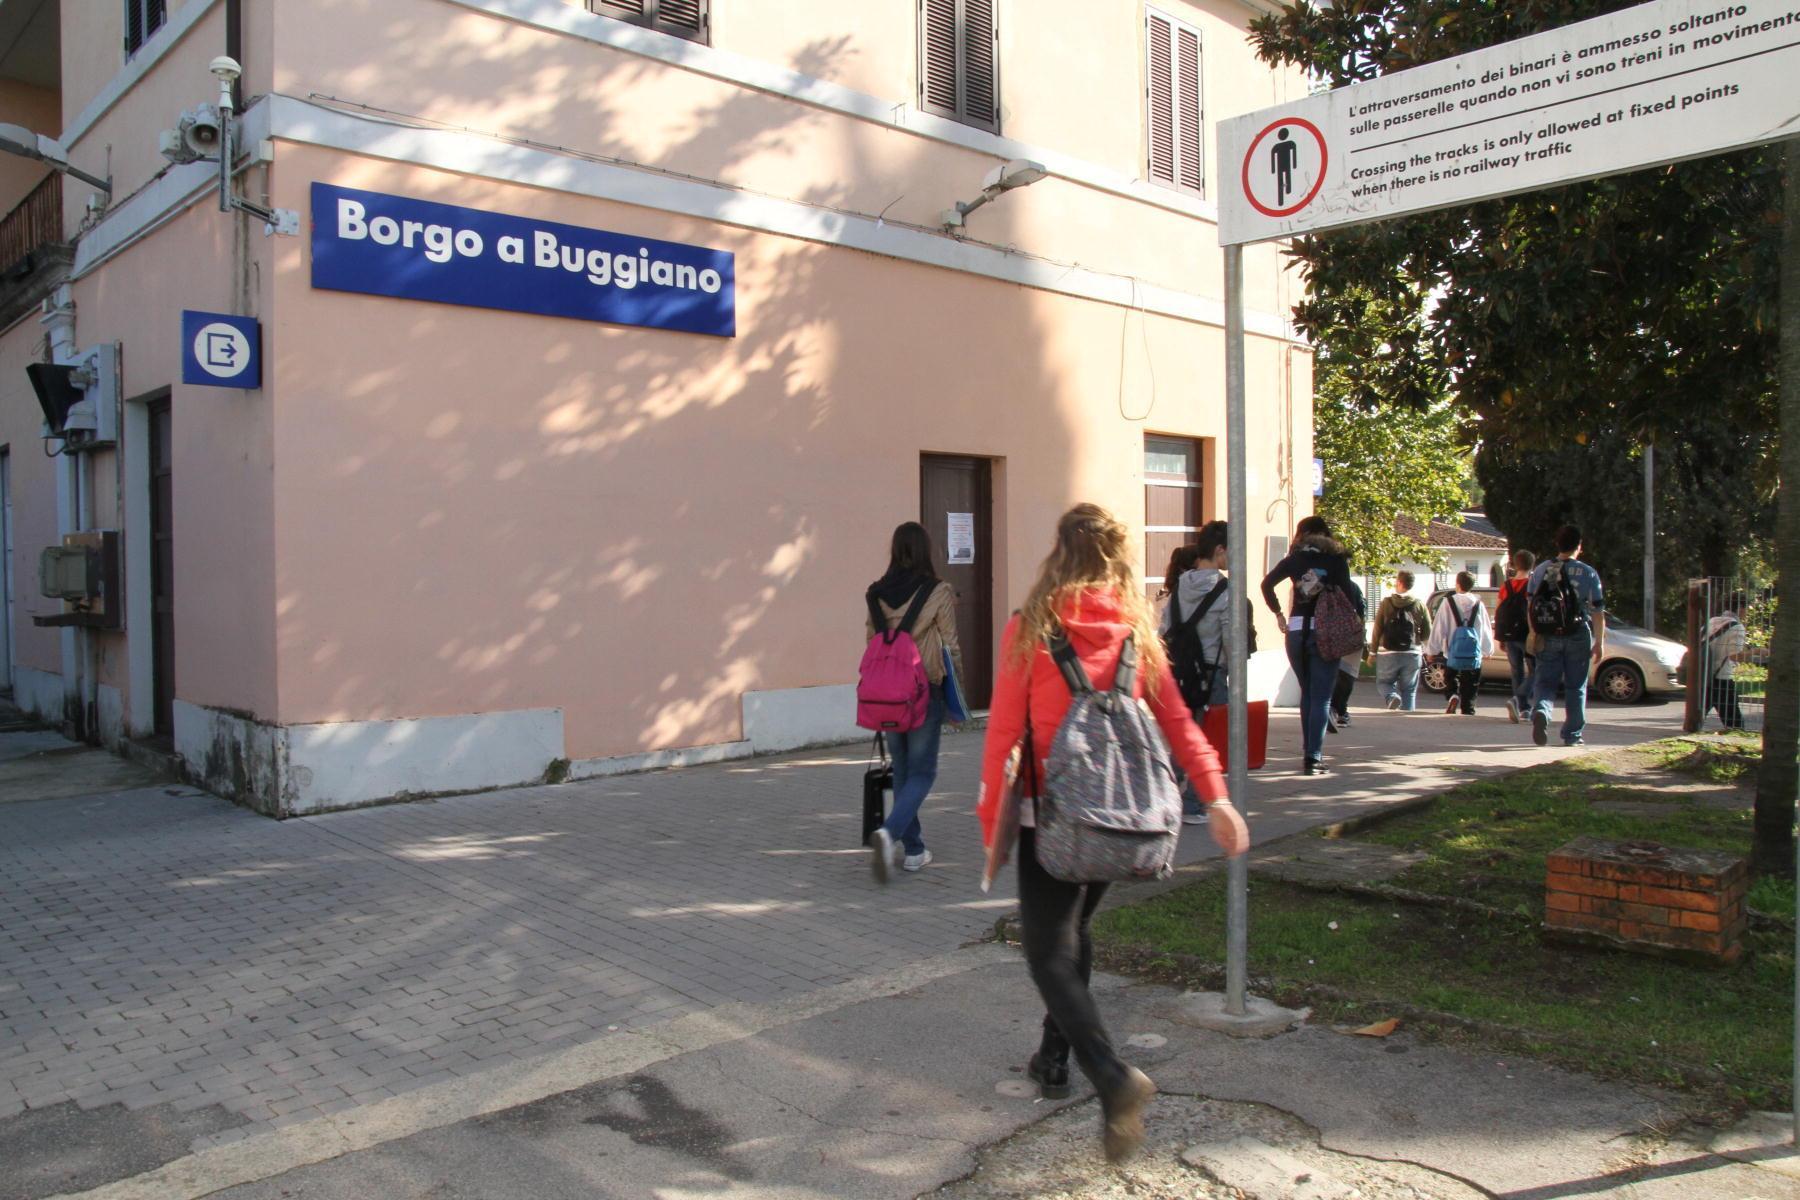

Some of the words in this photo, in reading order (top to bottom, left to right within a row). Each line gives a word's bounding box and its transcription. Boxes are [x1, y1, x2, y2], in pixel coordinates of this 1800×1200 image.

[1349, 120, 1380, 136] sulle
[1384, 100, 1455, 130] passerelle
[1459, 86, 1518, 111] quando
[1521, 78, 1551, 94] non
[1556, 70, 1570, 84] vi
[1575, 61, 1617, 80] sono
[1621, 46, 1663, 69] treni
[1669, 43, 1686, 57] in
[1481, 68, 1504, 84] dei
[1509, 54, 1556, 77] binari
[1562, 50, 1572, 63] è
[1578, 28, 1662, 59] ammesso
[1669, 5, 1747, 35] soltanto
[1350, 160, 1407, 180] Crossing
[1409, 154, 1432, 168] the
[1434, 143, 1479, 162] tracks
[1483, 139, 1496, 151] is
[1499, 131, 1534, 146] only
[1537, 112, 1602, 139] allowed
[1606, 110, 1624, 124] at
[1629, 95, 1676, 118] fixed
[1681, 83, 1740, 110] points
[1351, 182, 1388, 198] when
[1390, 175, 1427, 190] there
[1429, 170, 1440, 183] is
[1442, 167, 1462, 180] no
[1463, 154, 1521, 176] railway
[1524, 142, 1573, 162] traffic
[337, 198, 484, 263] Borgo
[496, 235, 524, 264] a
[534, 230, 722, 294] Buggiano
